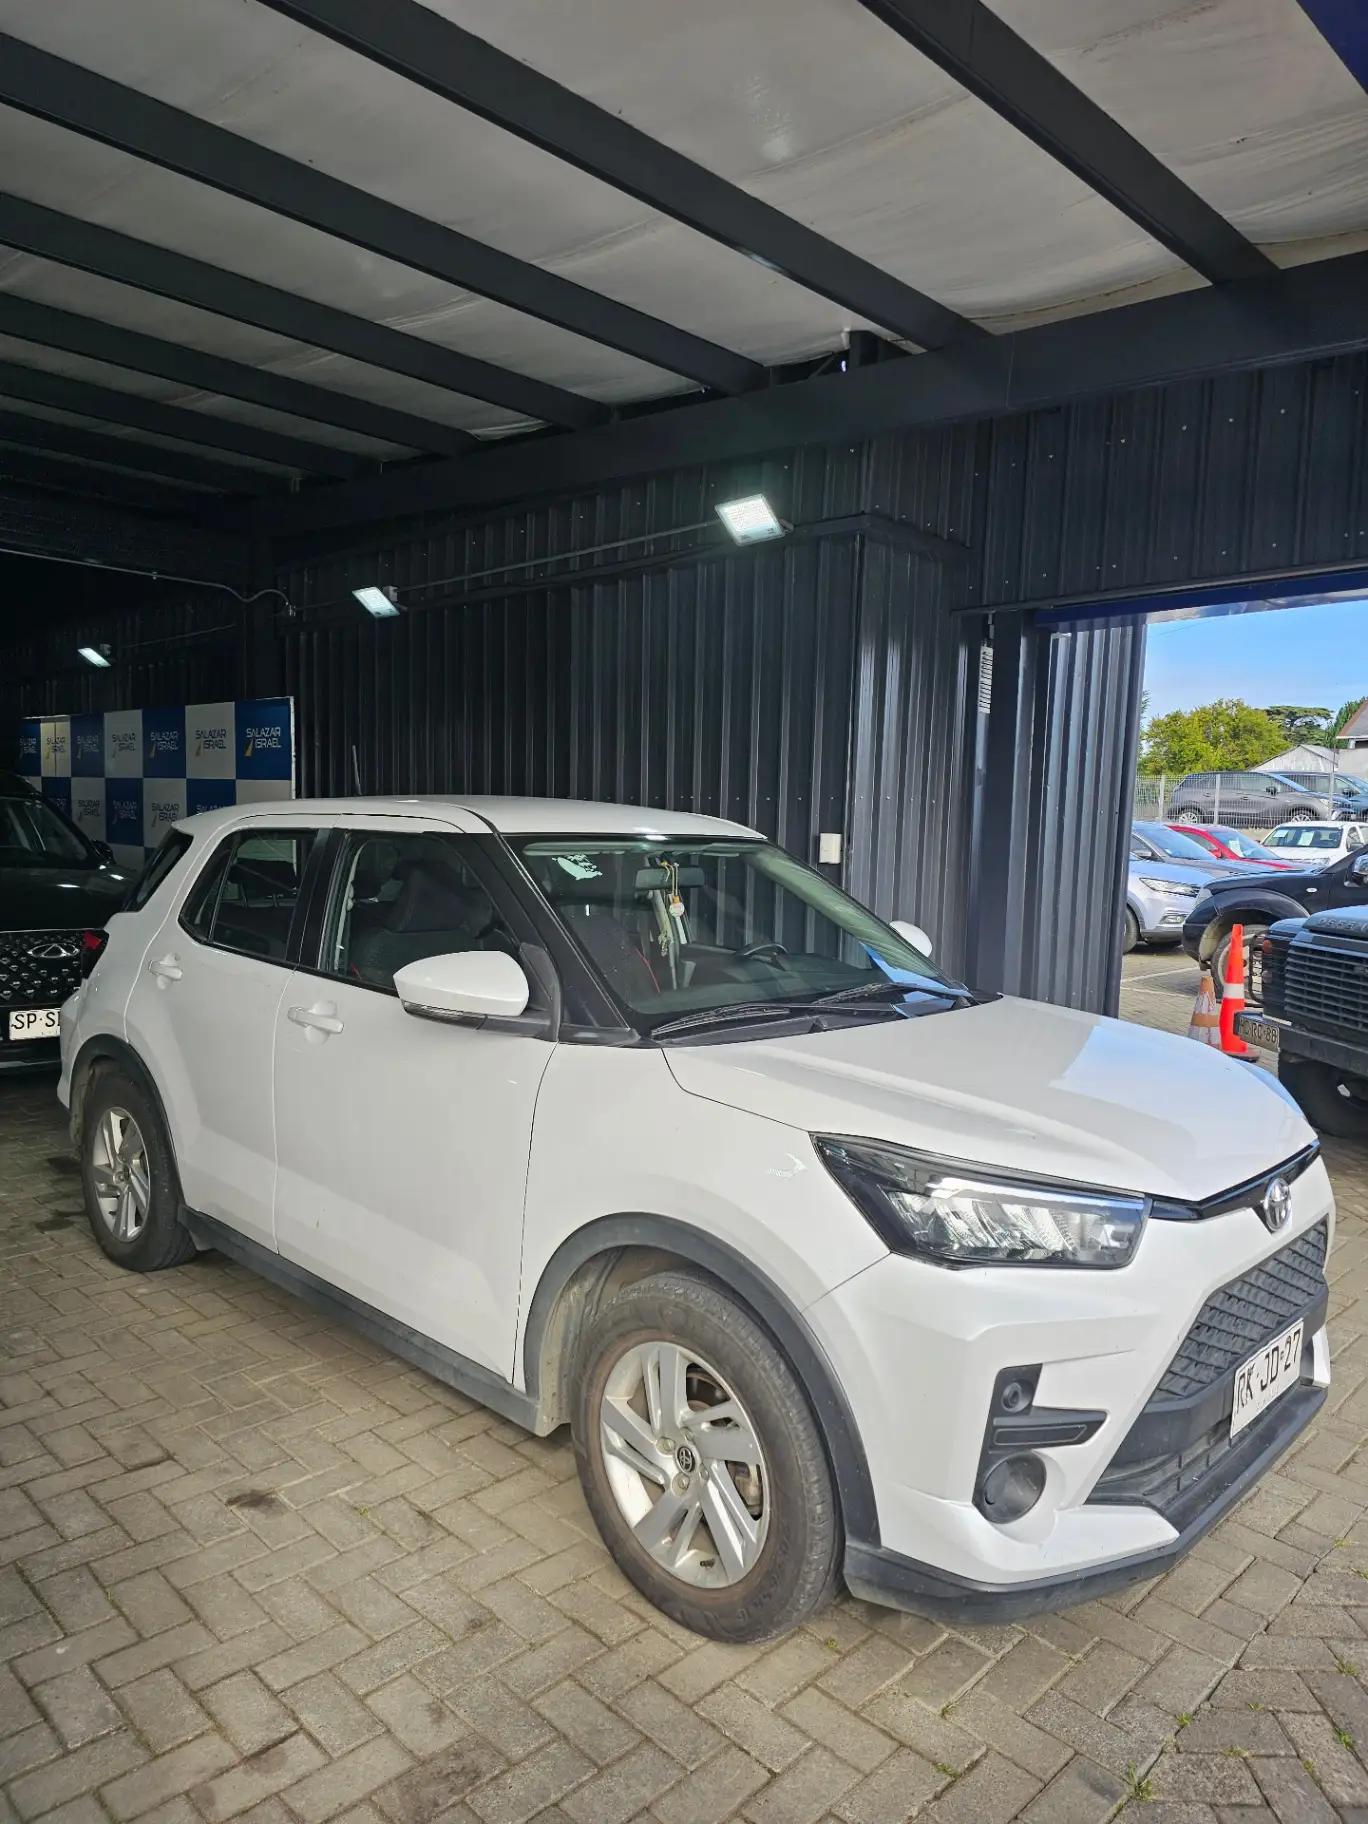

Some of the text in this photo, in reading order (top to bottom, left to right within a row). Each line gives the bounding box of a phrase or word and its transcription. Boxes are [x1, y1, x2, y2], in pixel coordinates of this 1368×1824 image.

[195, 729, 227, 739] SALAZAR
[246, 727, 281, 738] SALAZAR
[254, 738, 282, 749] ISRAEL
